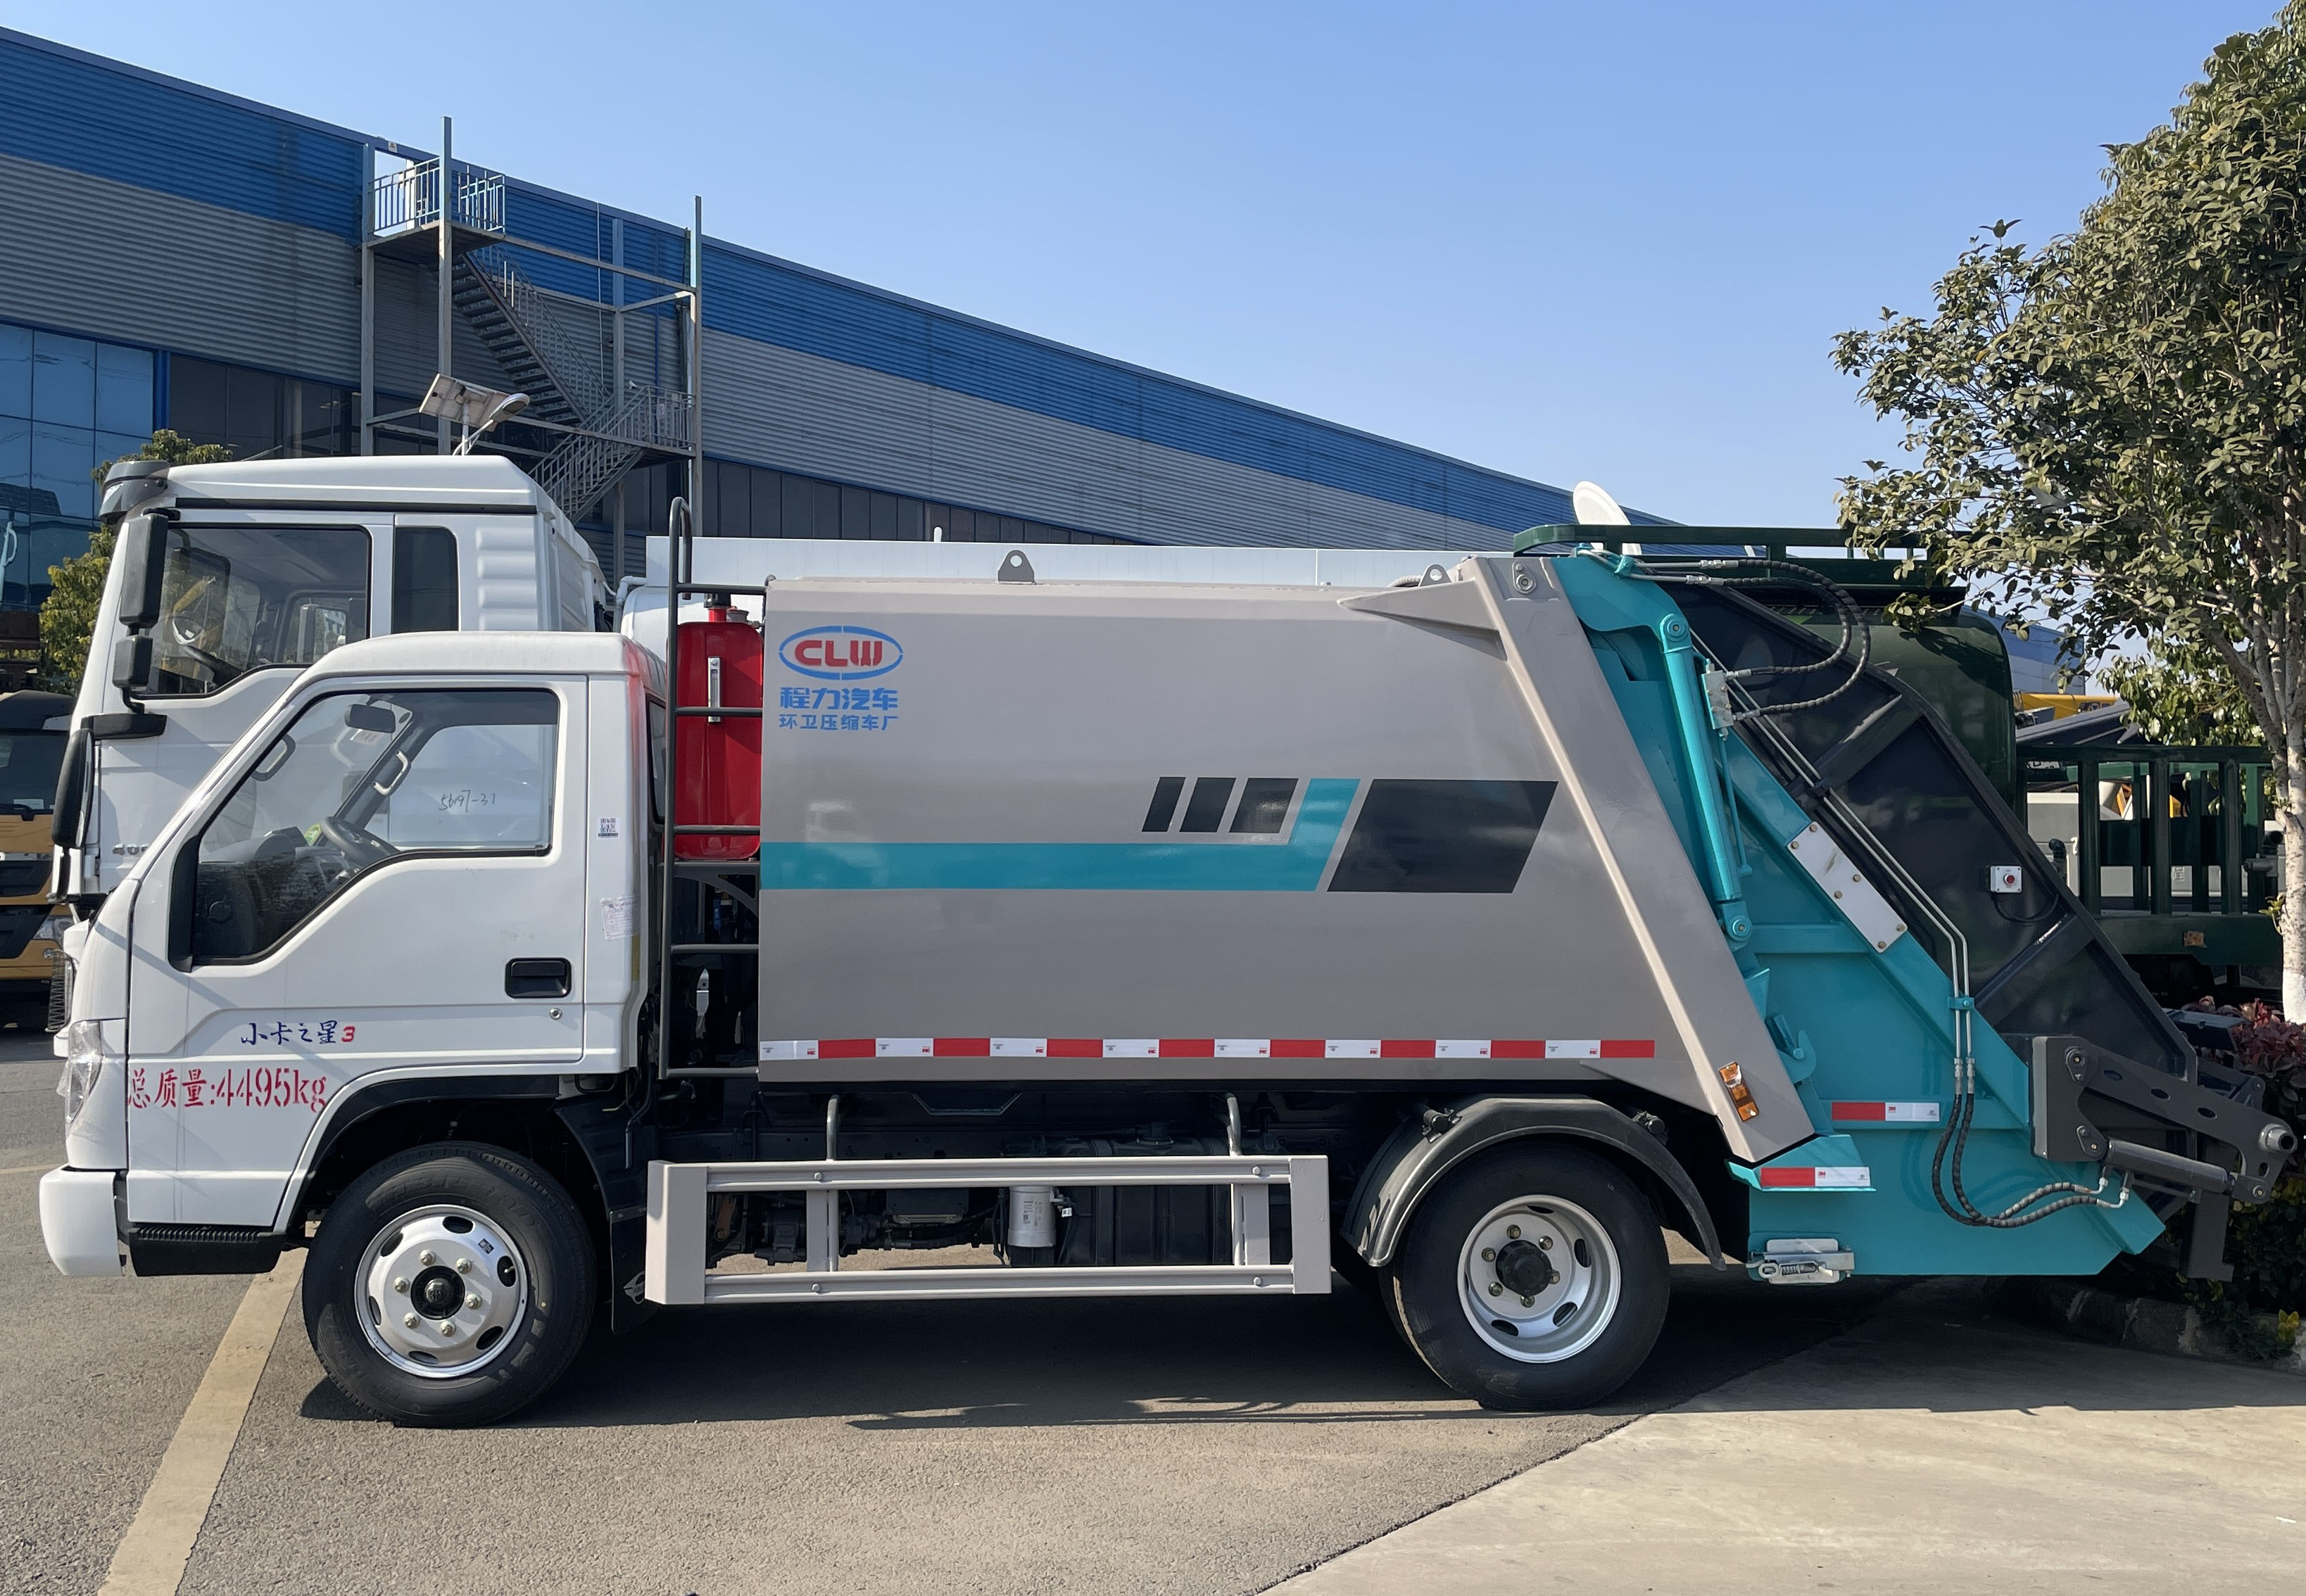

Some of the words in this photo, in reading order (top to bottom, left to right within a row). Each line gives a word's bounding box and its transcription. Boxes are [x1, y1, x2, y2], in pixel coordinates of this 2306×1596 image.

[794, 640, 883, 667] CLW
[779, 687, 898, 711] 程力汽车
[779, 714, 898, 730] 环卫压缩车厂
[127, 1066, 327, 1113] 总质量:4495kg
